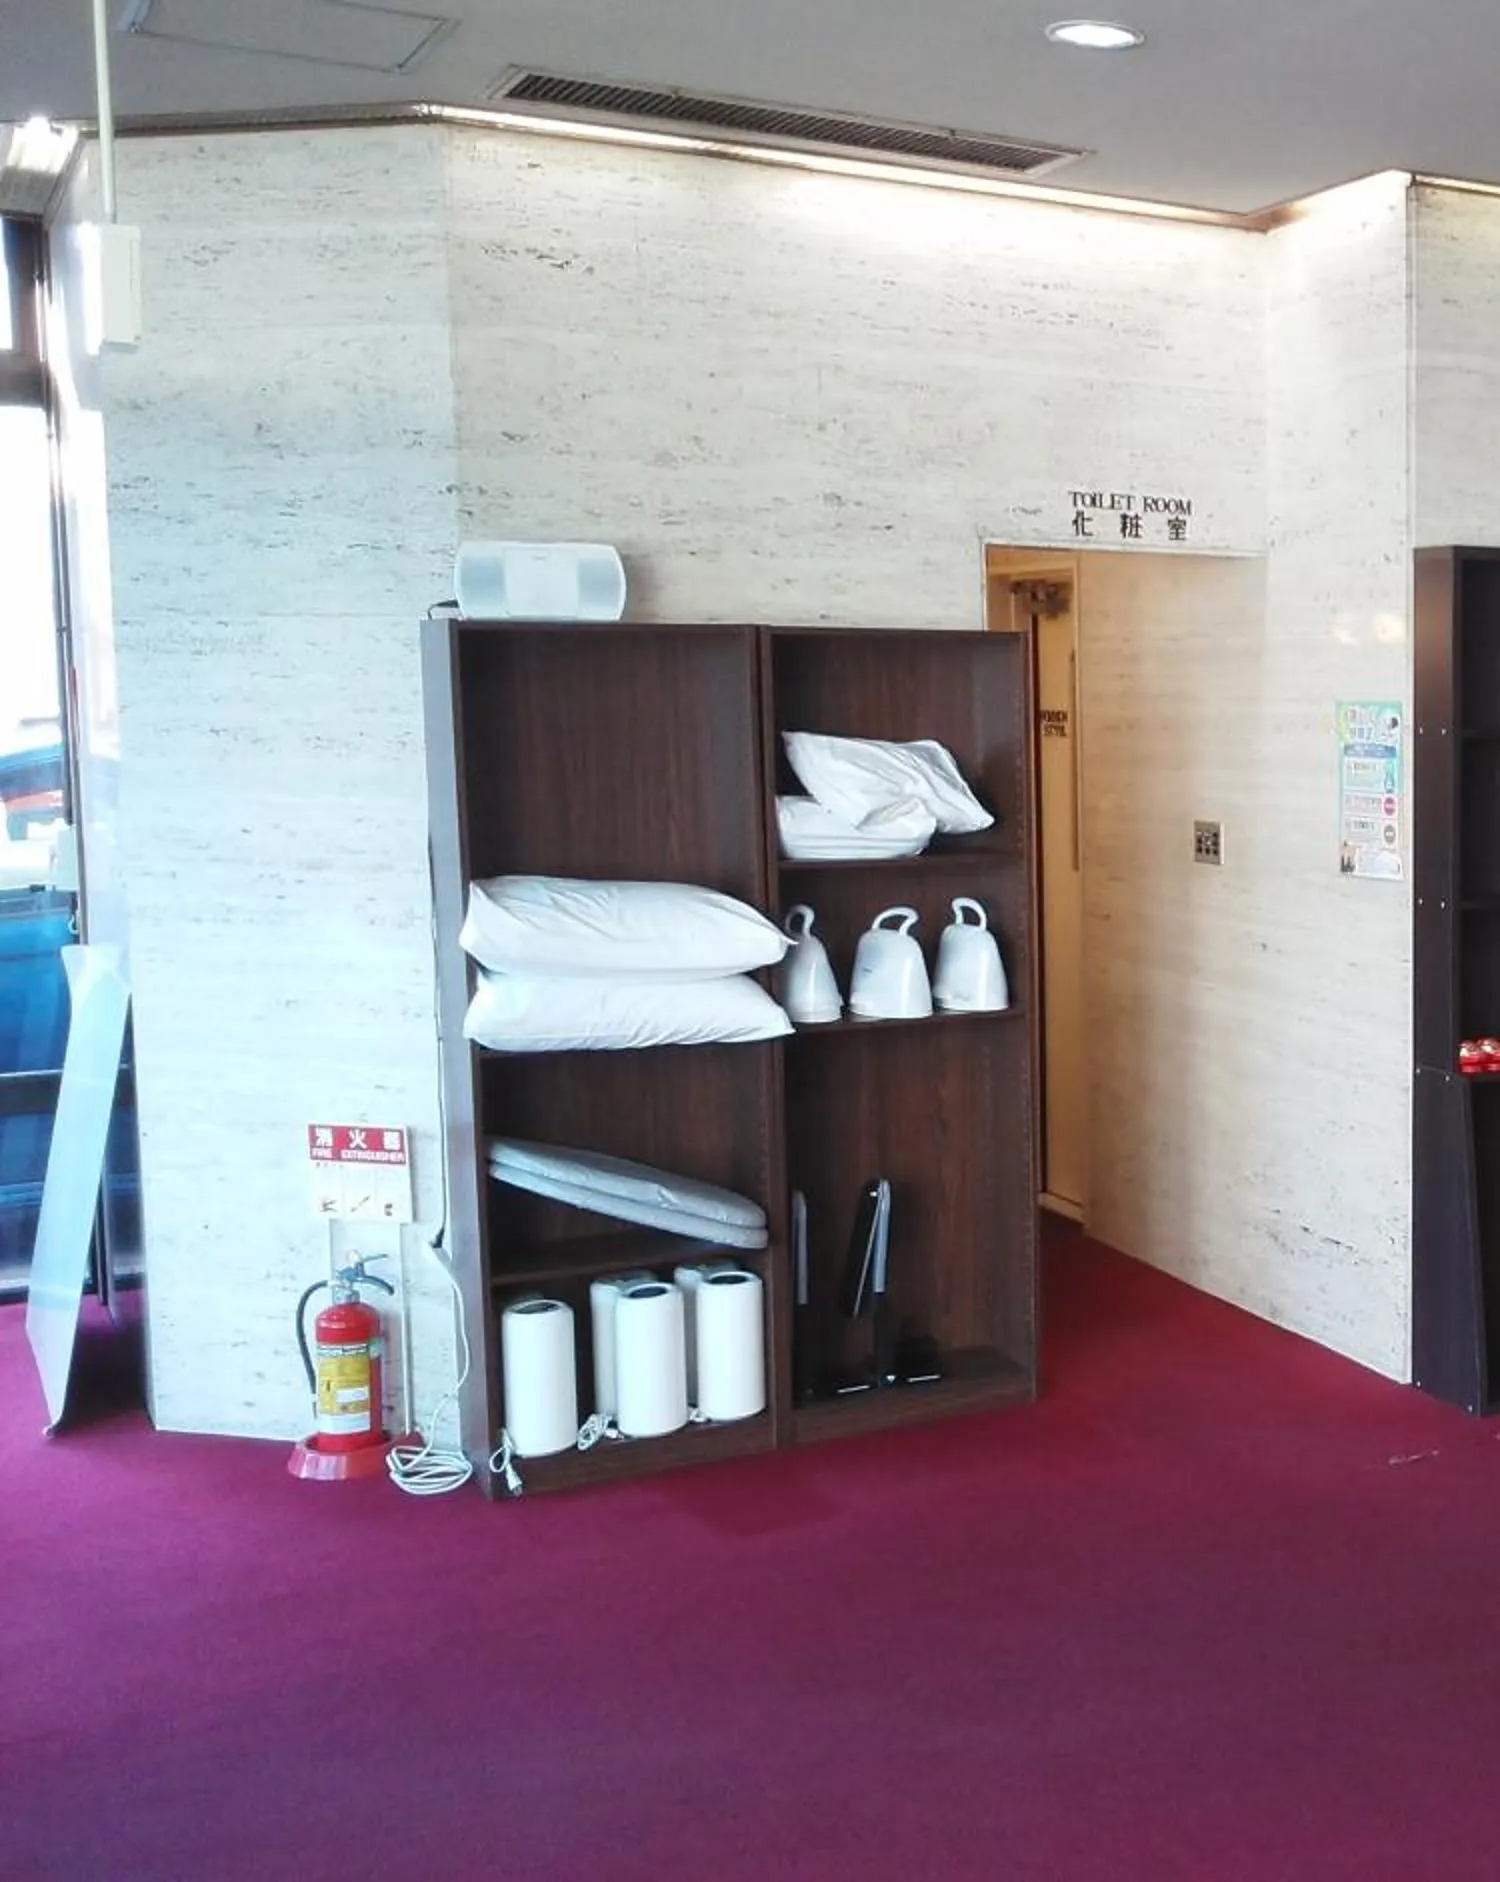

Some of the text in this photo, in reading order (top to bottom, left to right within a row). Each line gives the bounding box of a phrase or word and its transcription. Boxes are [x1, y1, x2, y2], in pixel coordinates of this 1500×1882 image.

[1068, 490, 1192, 516] TOILET ROOM
[1071, 509, 1188, 541] 化粧室
